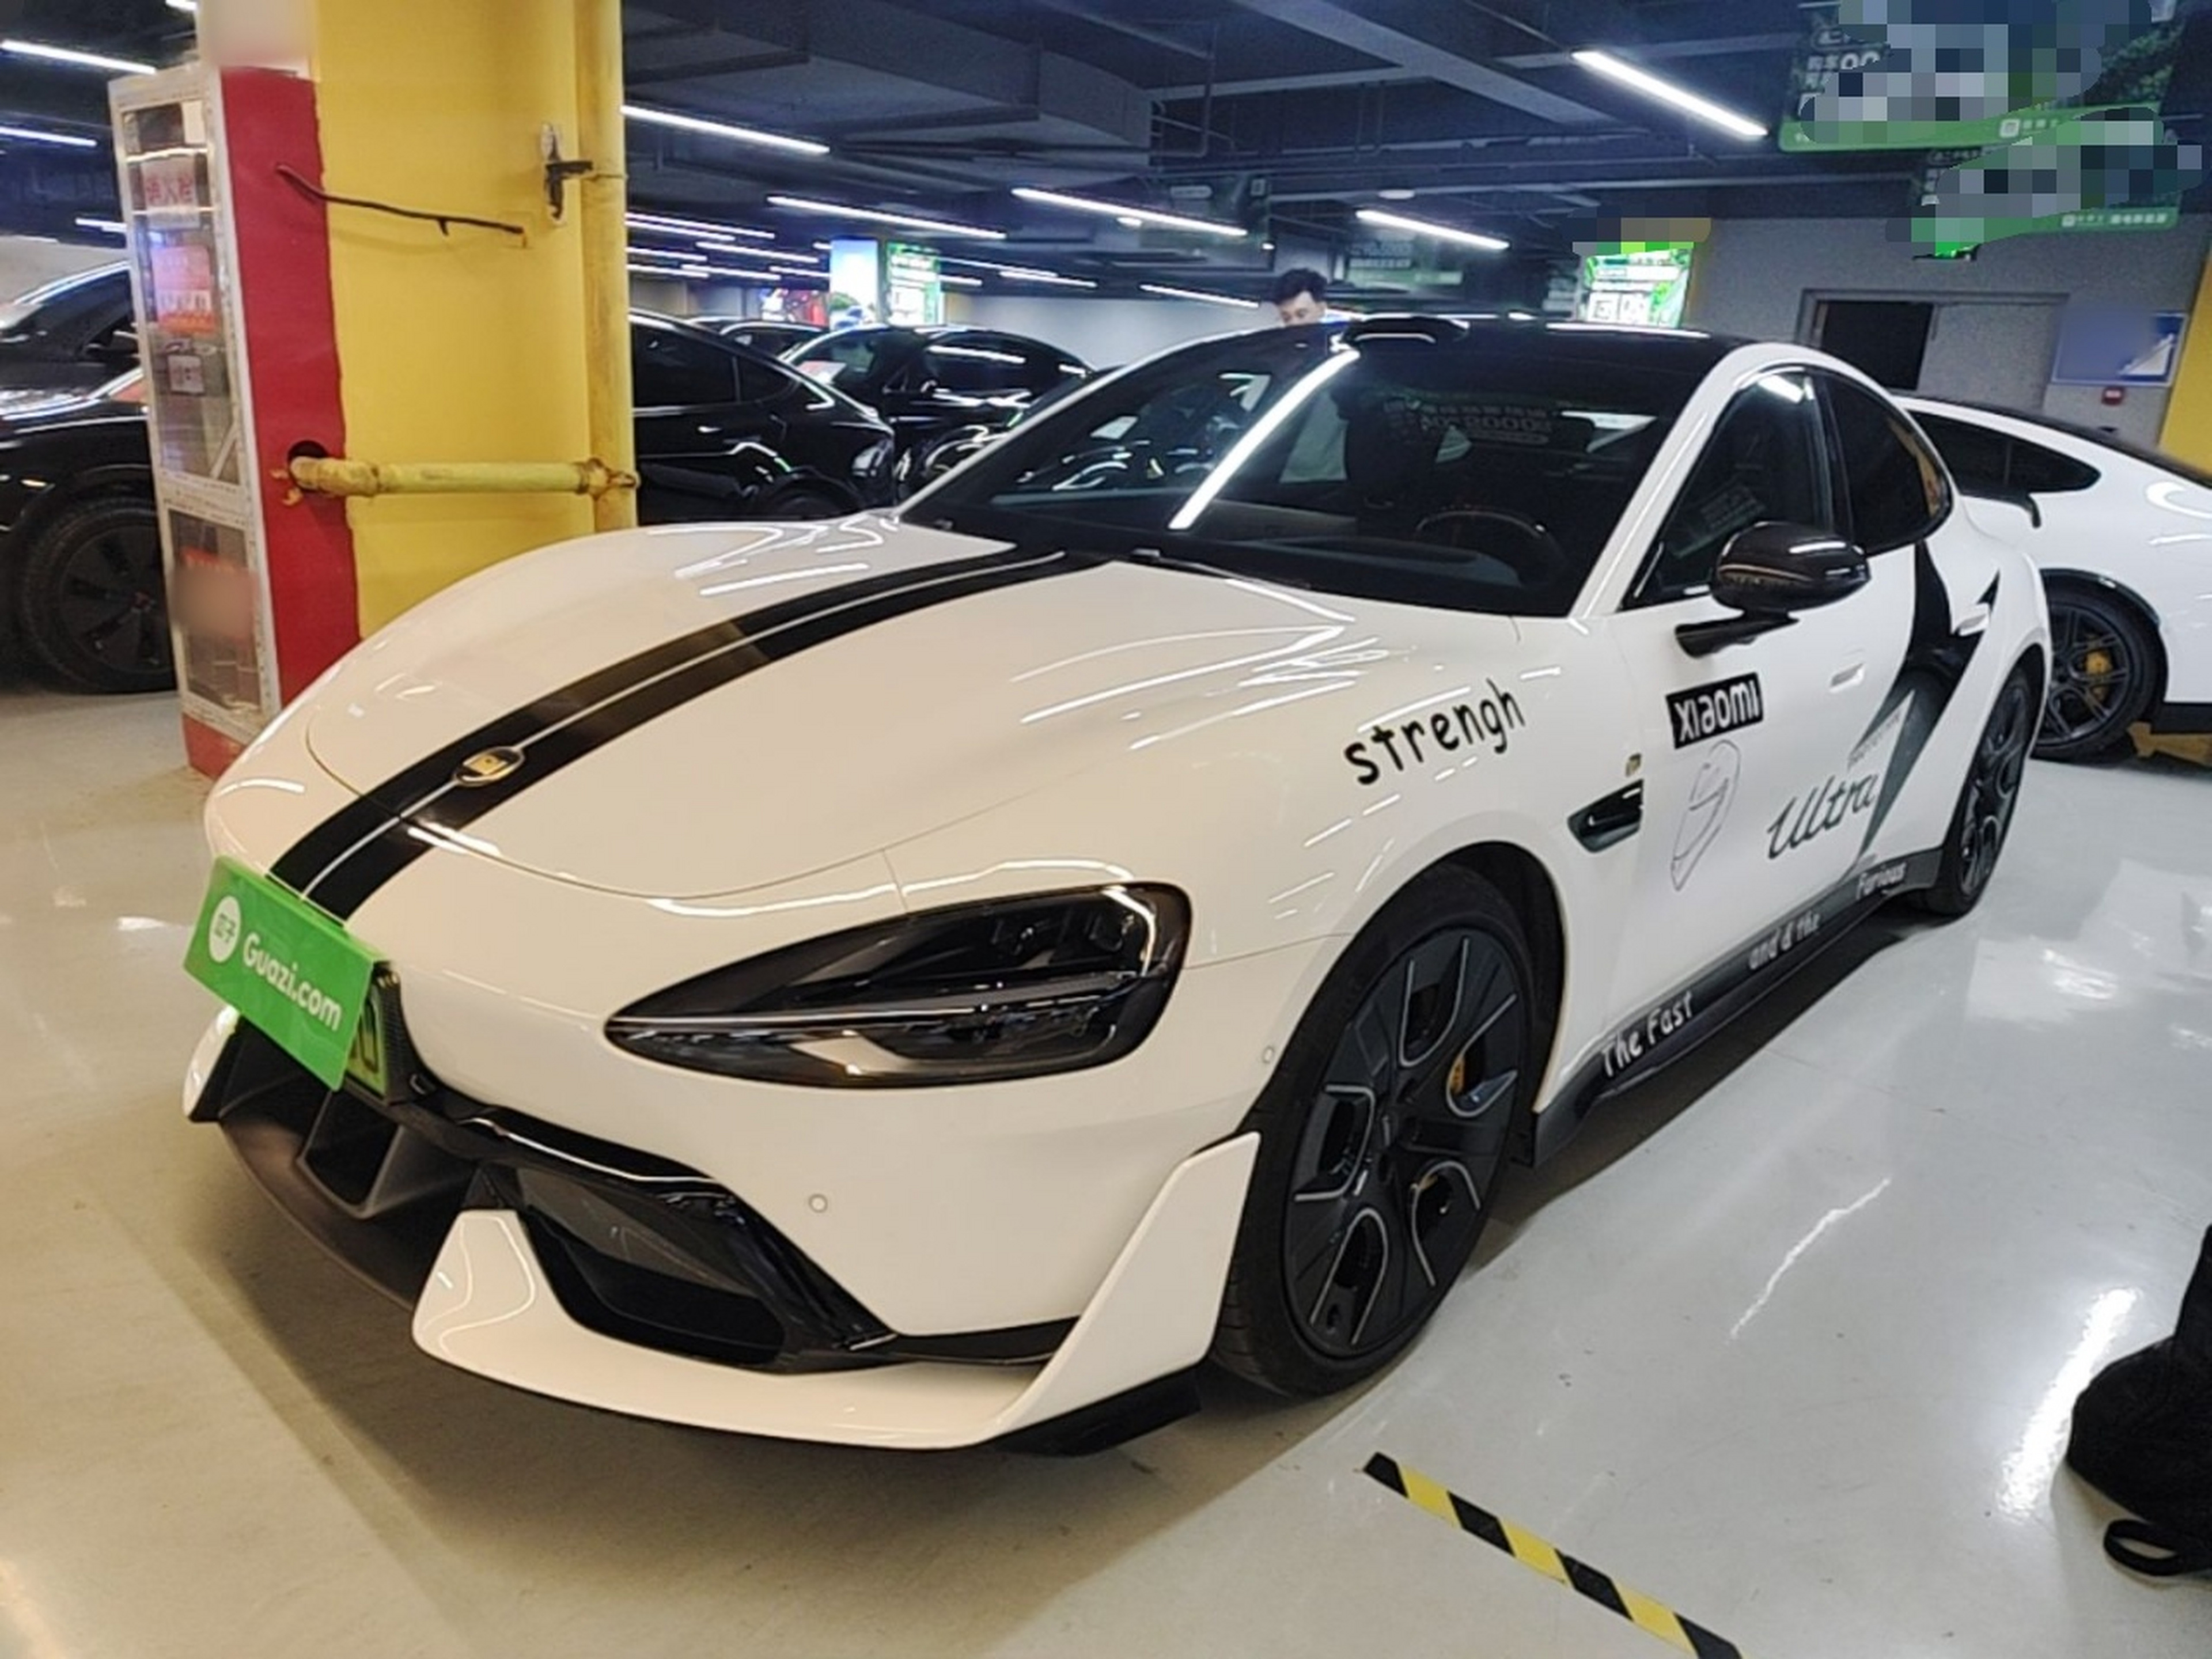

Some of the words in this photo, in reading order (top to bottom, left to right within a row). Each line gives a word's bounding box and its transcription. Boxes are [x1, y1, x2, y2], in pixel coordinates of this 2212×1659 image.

[1344, 678, 1525, 785] strengh
[1673, 680, 1760, 742] xiaomi
[1767, 774, 1877, 860] Ultra
[243, 931, 343, 1031] Guazi.com
[1601, 1029, 1643, 1078] The
[1646, 991, 1695, 1046] Fast
